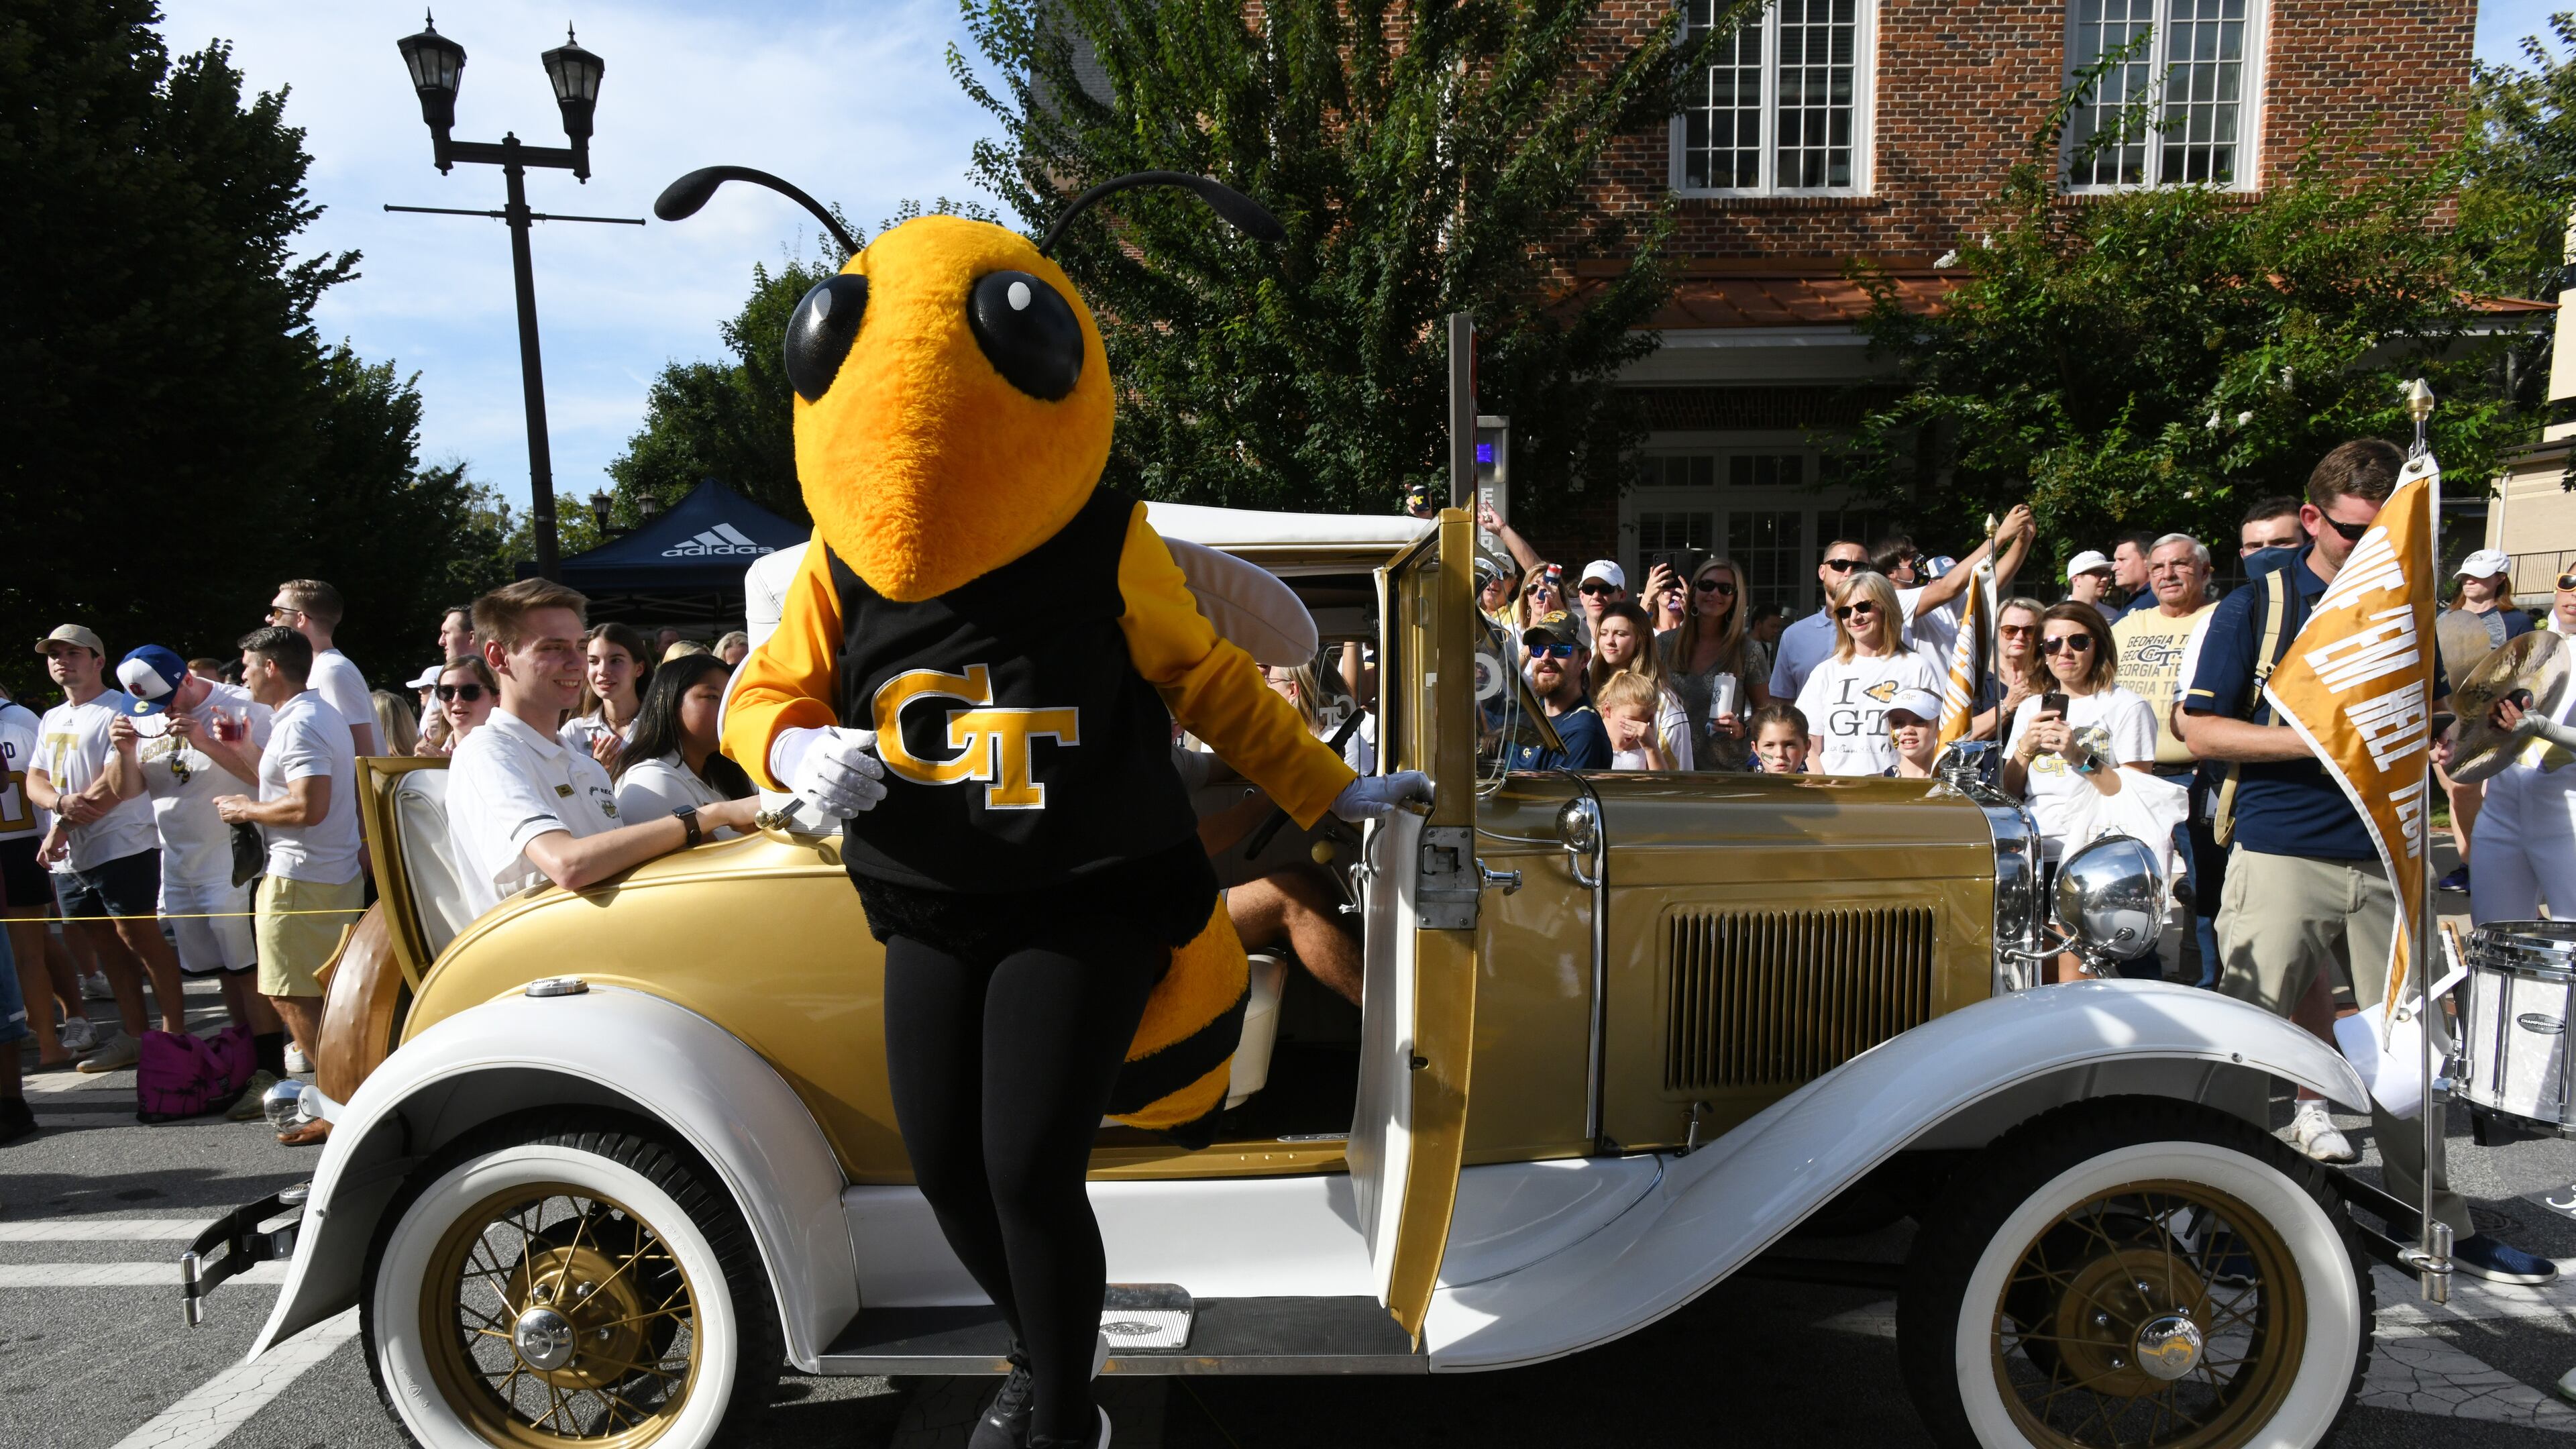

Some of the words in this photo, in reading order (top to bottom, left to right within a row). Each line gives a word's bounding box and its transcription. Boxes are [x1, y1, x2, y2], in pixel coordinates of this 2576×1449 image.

[661, 544, 776, 557] adidas
[2127, 635, 2174, 648] GEORGIA
[2137, 644, 2182, 667] GT
[1833, 678, 1860, 705] I
[1829, 709, 1889, 737] GT
[2344, 678, 2428, 773] HELL
[871, 663, 1081, 810] GT
[2032, 752, 2072, 777] GT
